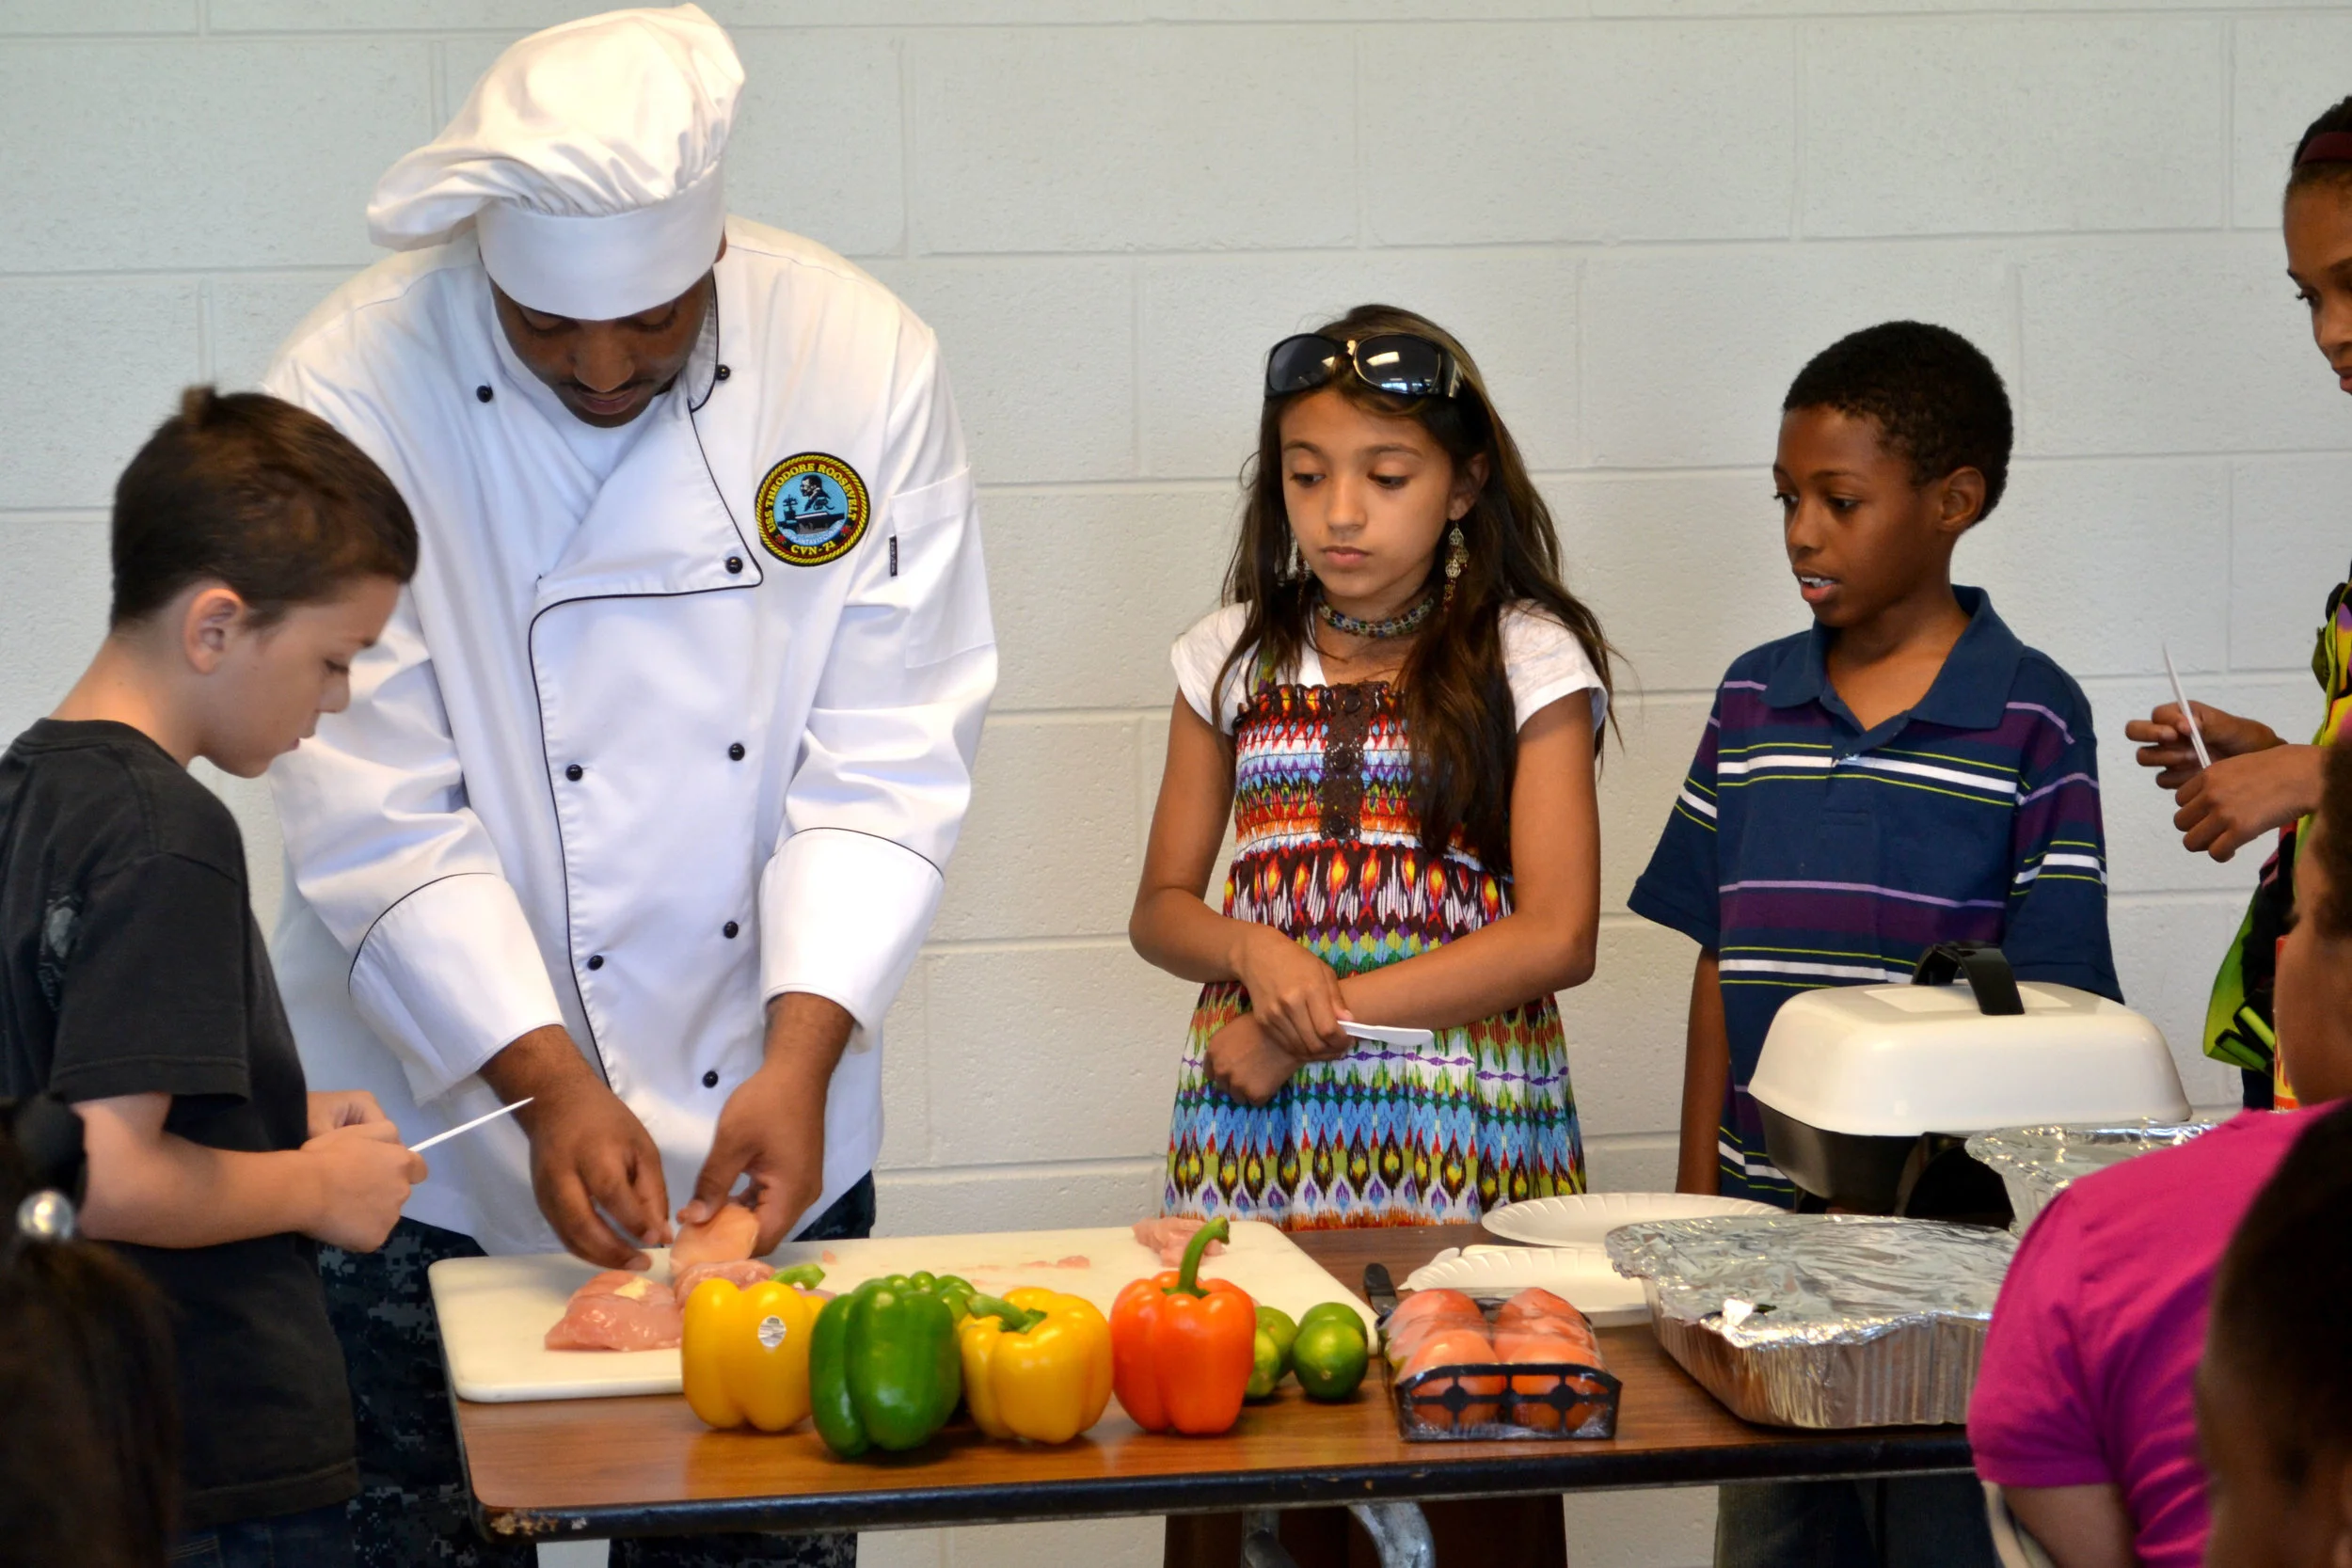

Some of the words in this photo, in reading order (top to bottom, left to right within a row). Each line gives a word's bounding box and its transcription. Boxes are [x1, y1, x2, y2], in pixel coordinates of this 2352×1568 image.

[765, 463, 816, 508] THEODORE
[818, 464, 858, 521] ROOSEVELT
[764, 510, 776, 533] USS
